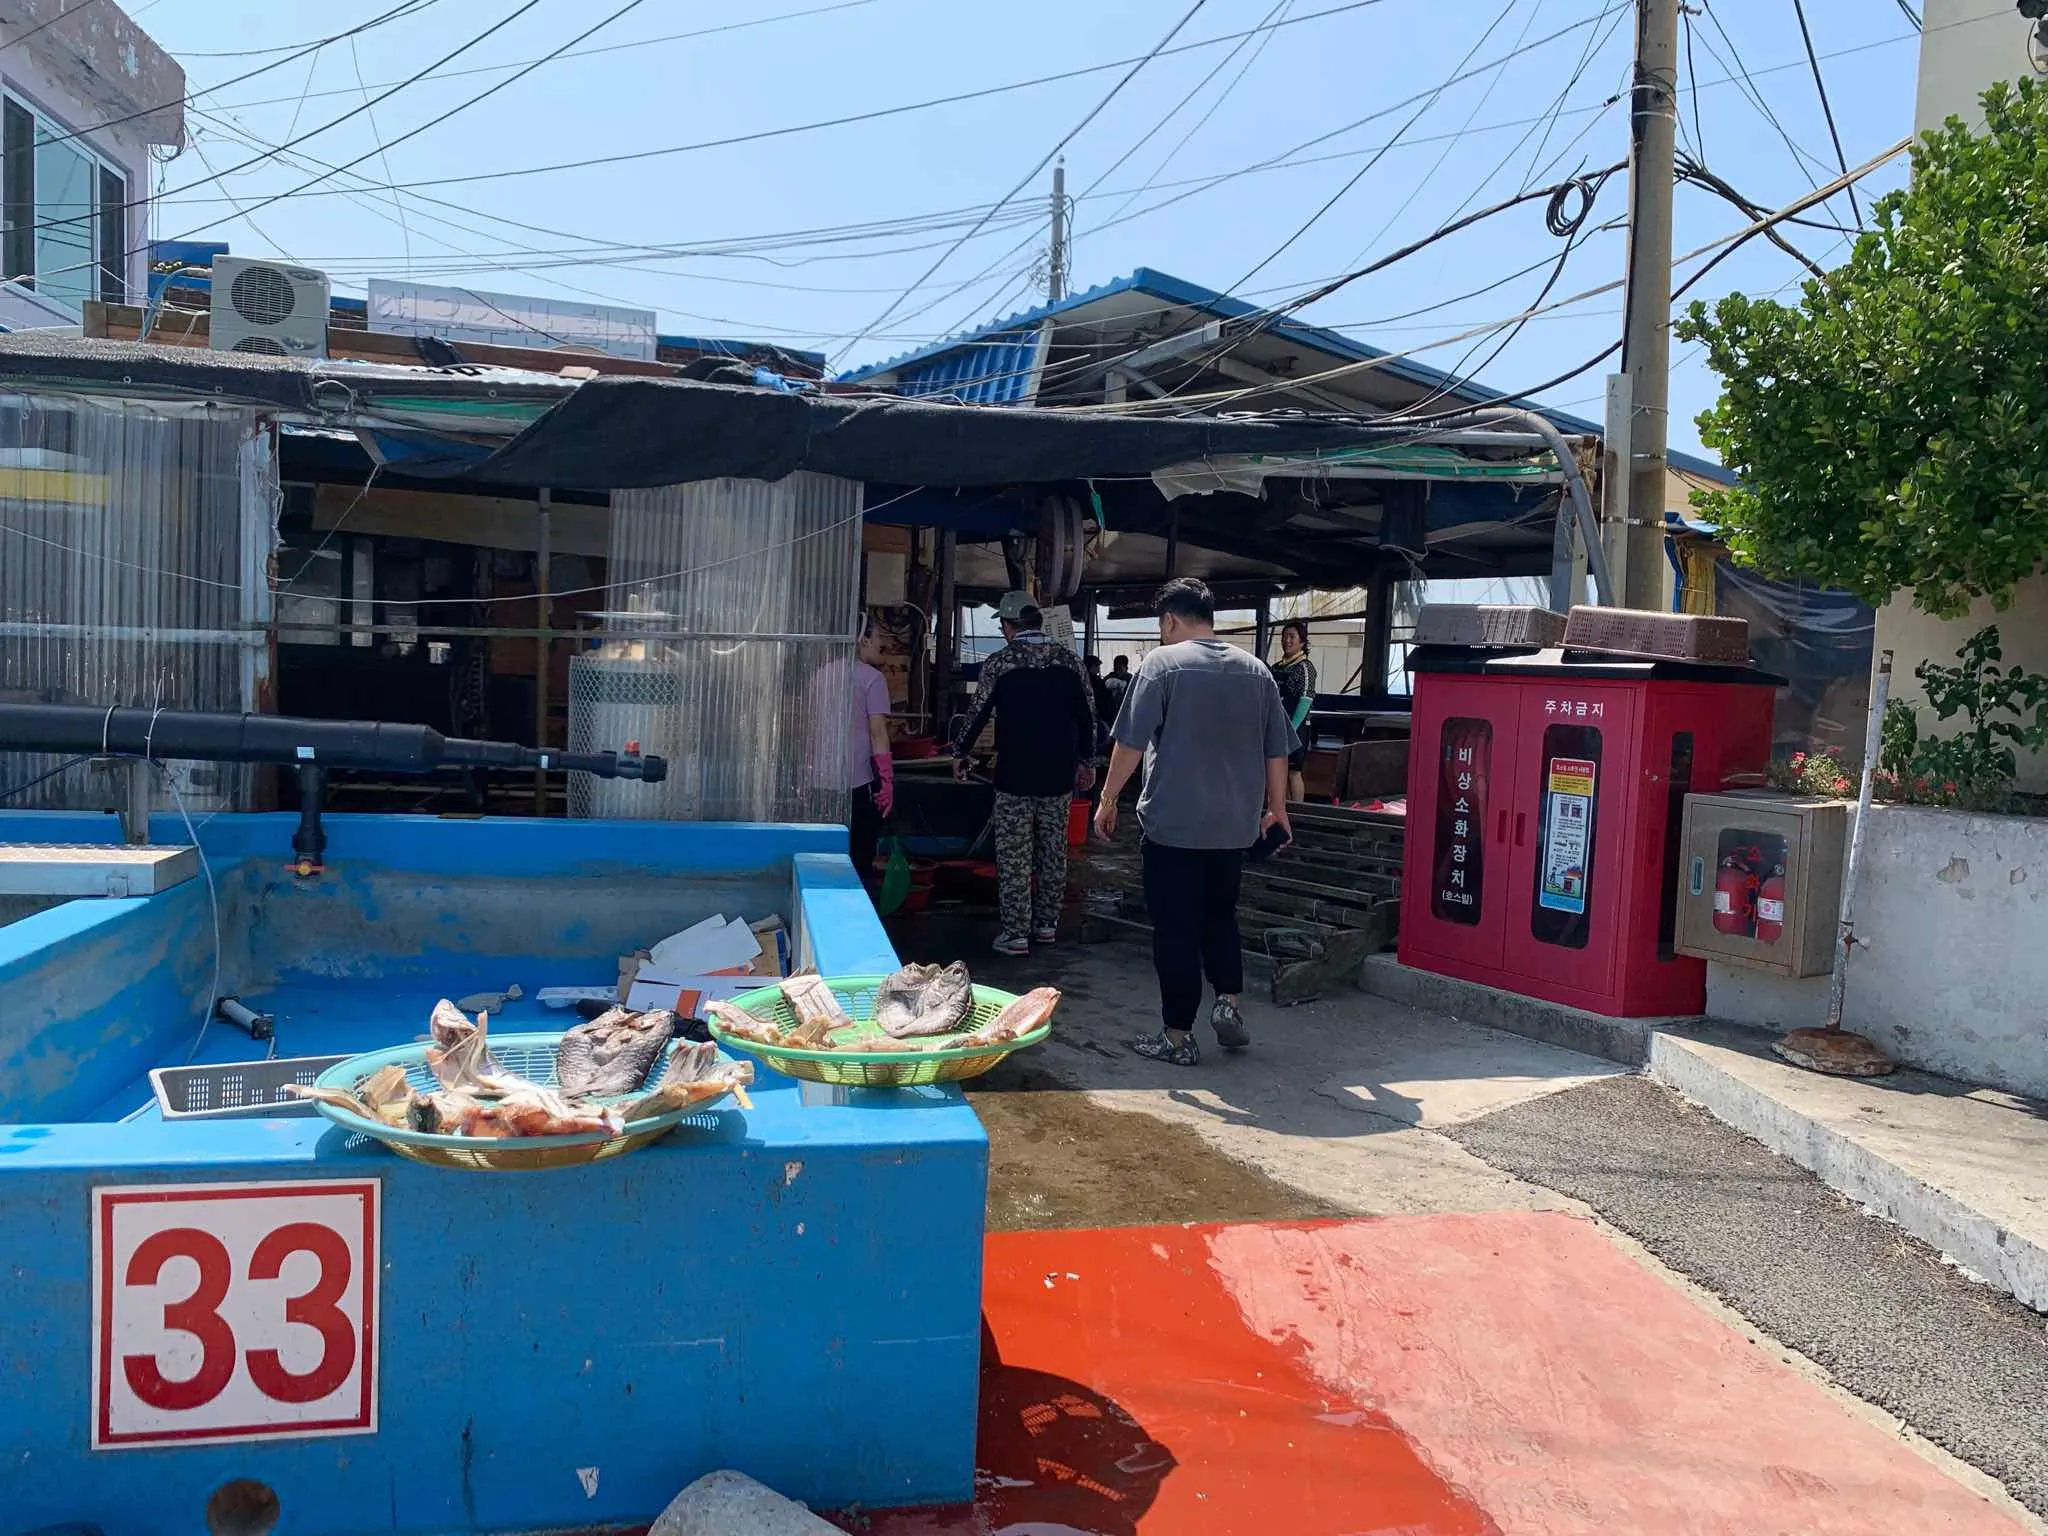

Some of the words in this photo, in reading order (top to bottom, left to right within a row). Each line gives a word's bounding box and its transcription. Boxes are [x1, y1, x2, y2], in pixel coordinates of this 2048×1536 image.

[1545, 699, 1604, 717] 주차금지
[1451, 747, 1472, 888] 비상소화장치
[123, 1222, 356, 1411] 33
